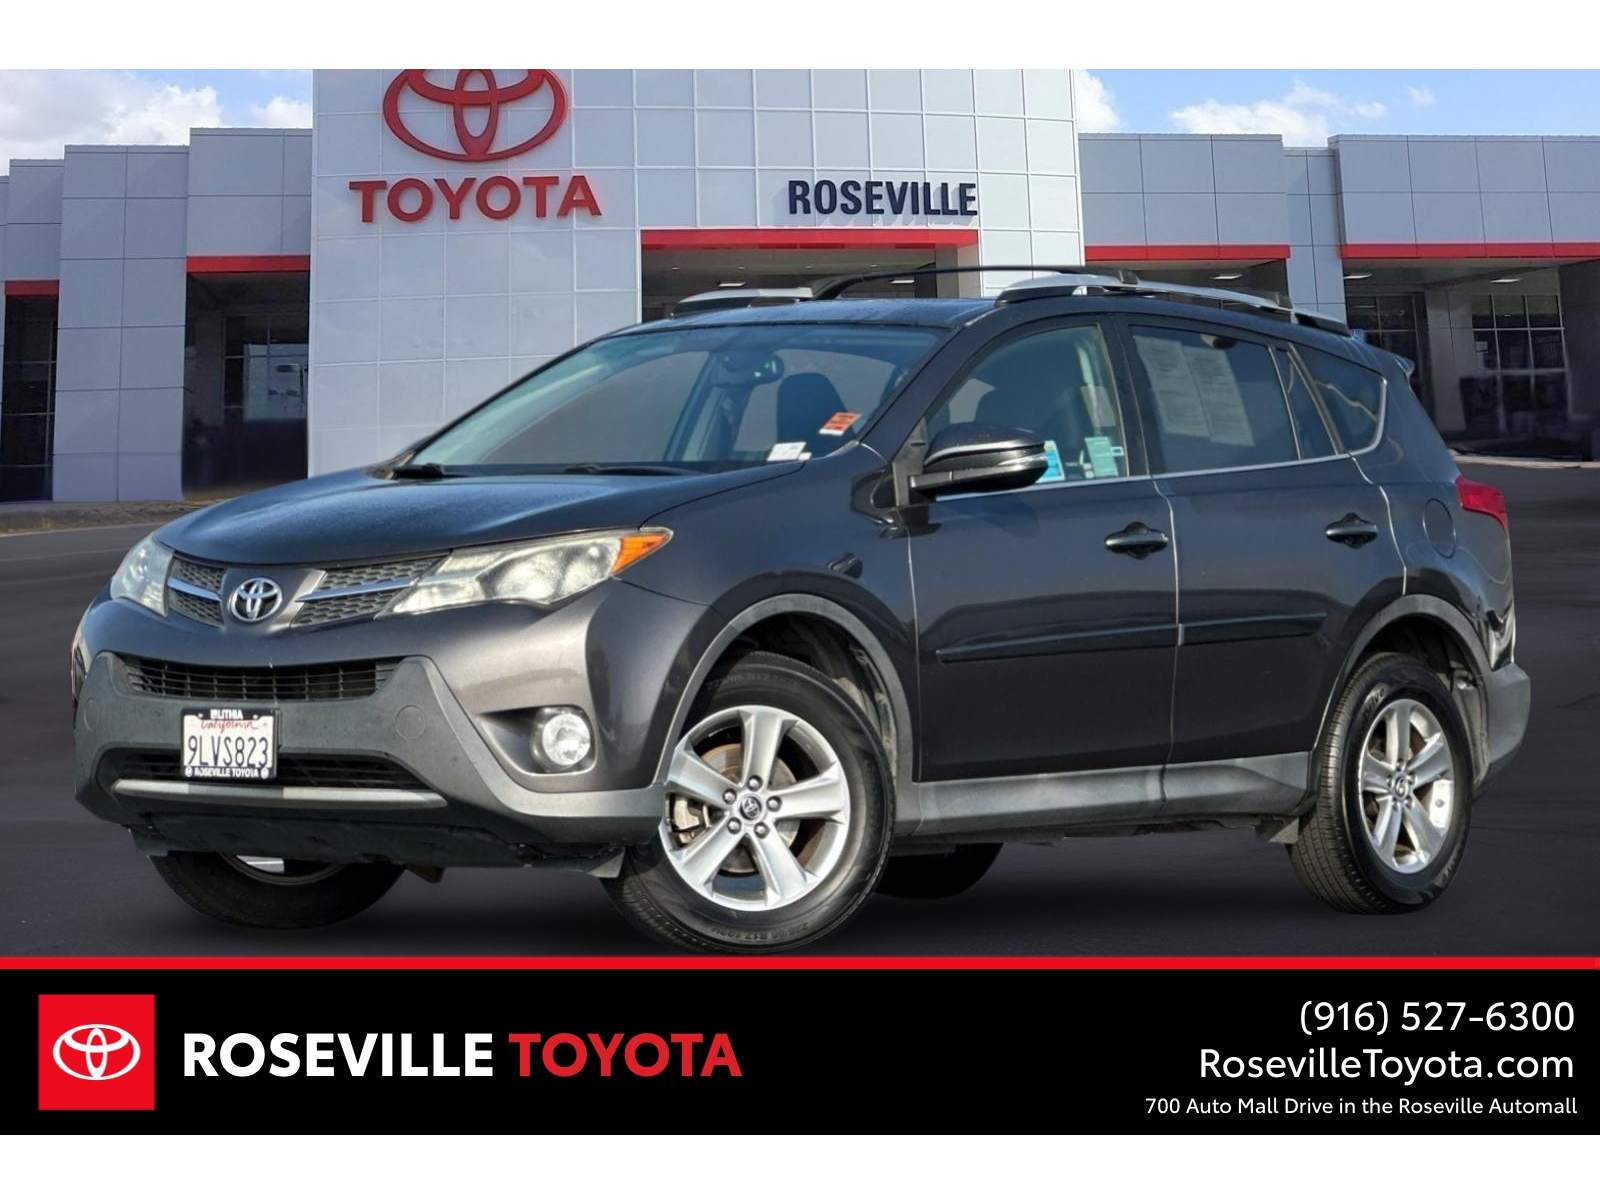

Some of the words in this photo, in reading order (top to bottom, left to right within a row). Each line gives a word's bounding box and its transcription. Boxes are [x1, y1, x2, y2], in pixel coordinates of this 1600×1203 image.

[349, 175, 602, 222] TOYOTA
[788, 180, 978, 216] ROSEVILLE
[188, 735, 268, 768] 9LVS823
[194, 767, 231, 777] ROSEVILLE
[232, 768, 259, 777] TOYOTA
